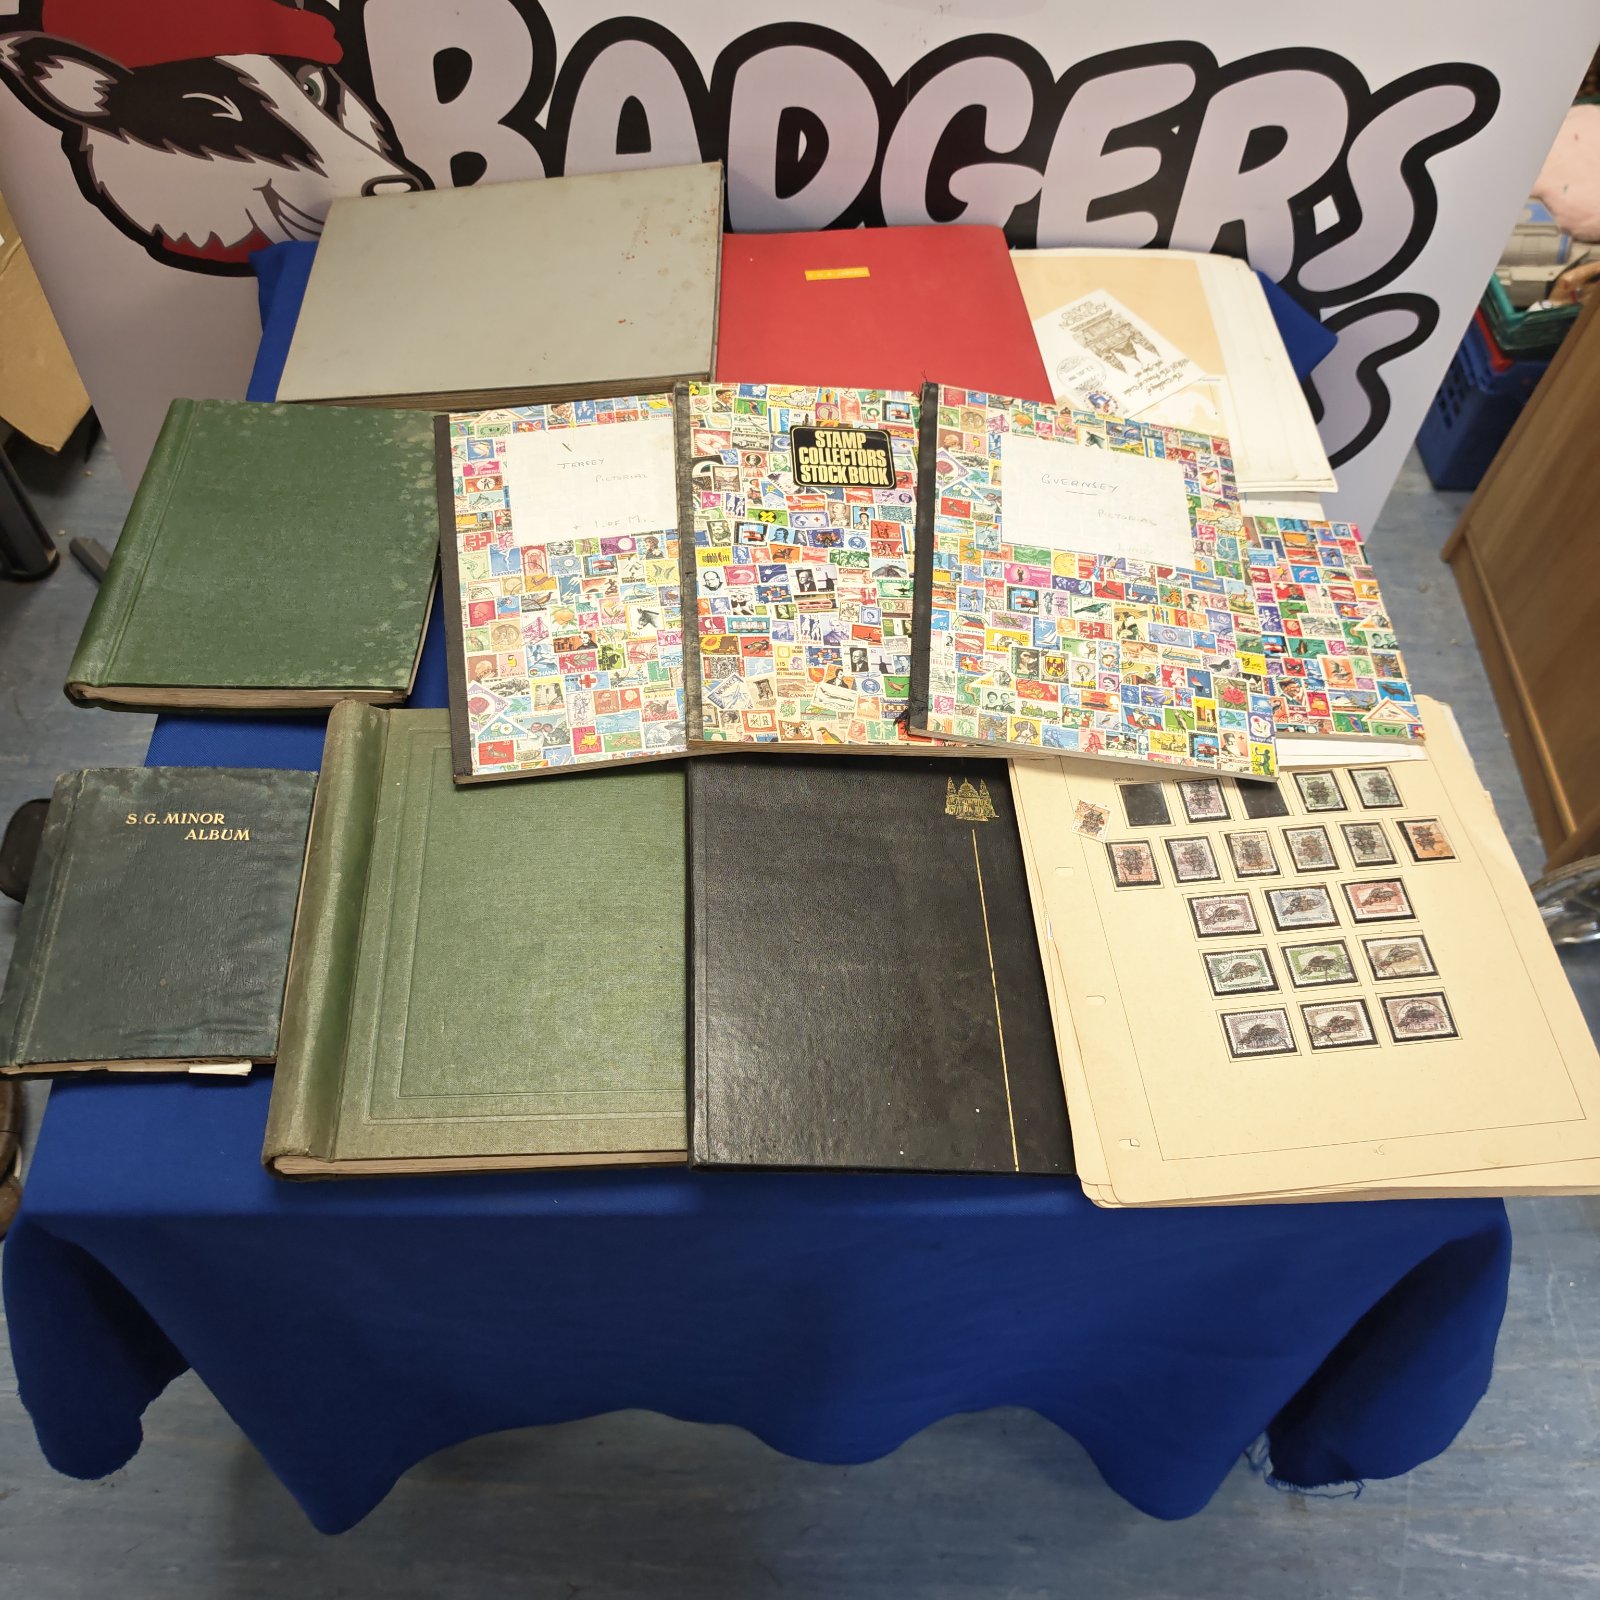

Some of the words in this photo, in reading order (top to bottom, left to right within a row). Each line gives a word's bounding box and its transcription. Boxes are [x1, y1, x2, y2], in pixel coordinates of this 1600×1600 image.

[356, 0, 1501, 302] BADGERS
[815, 431, 866, 449] STAMP
[798, 447, 887, 467] COLLECTORS
[800, 464, 849, 484] STOCK
[849, 467, 889, 485] BOOK
[1040, 473, 1121, 494] GUERNSEY
[163, 813, 225, 825] MINOR
[184, 828, 251, 841] ALBUM
